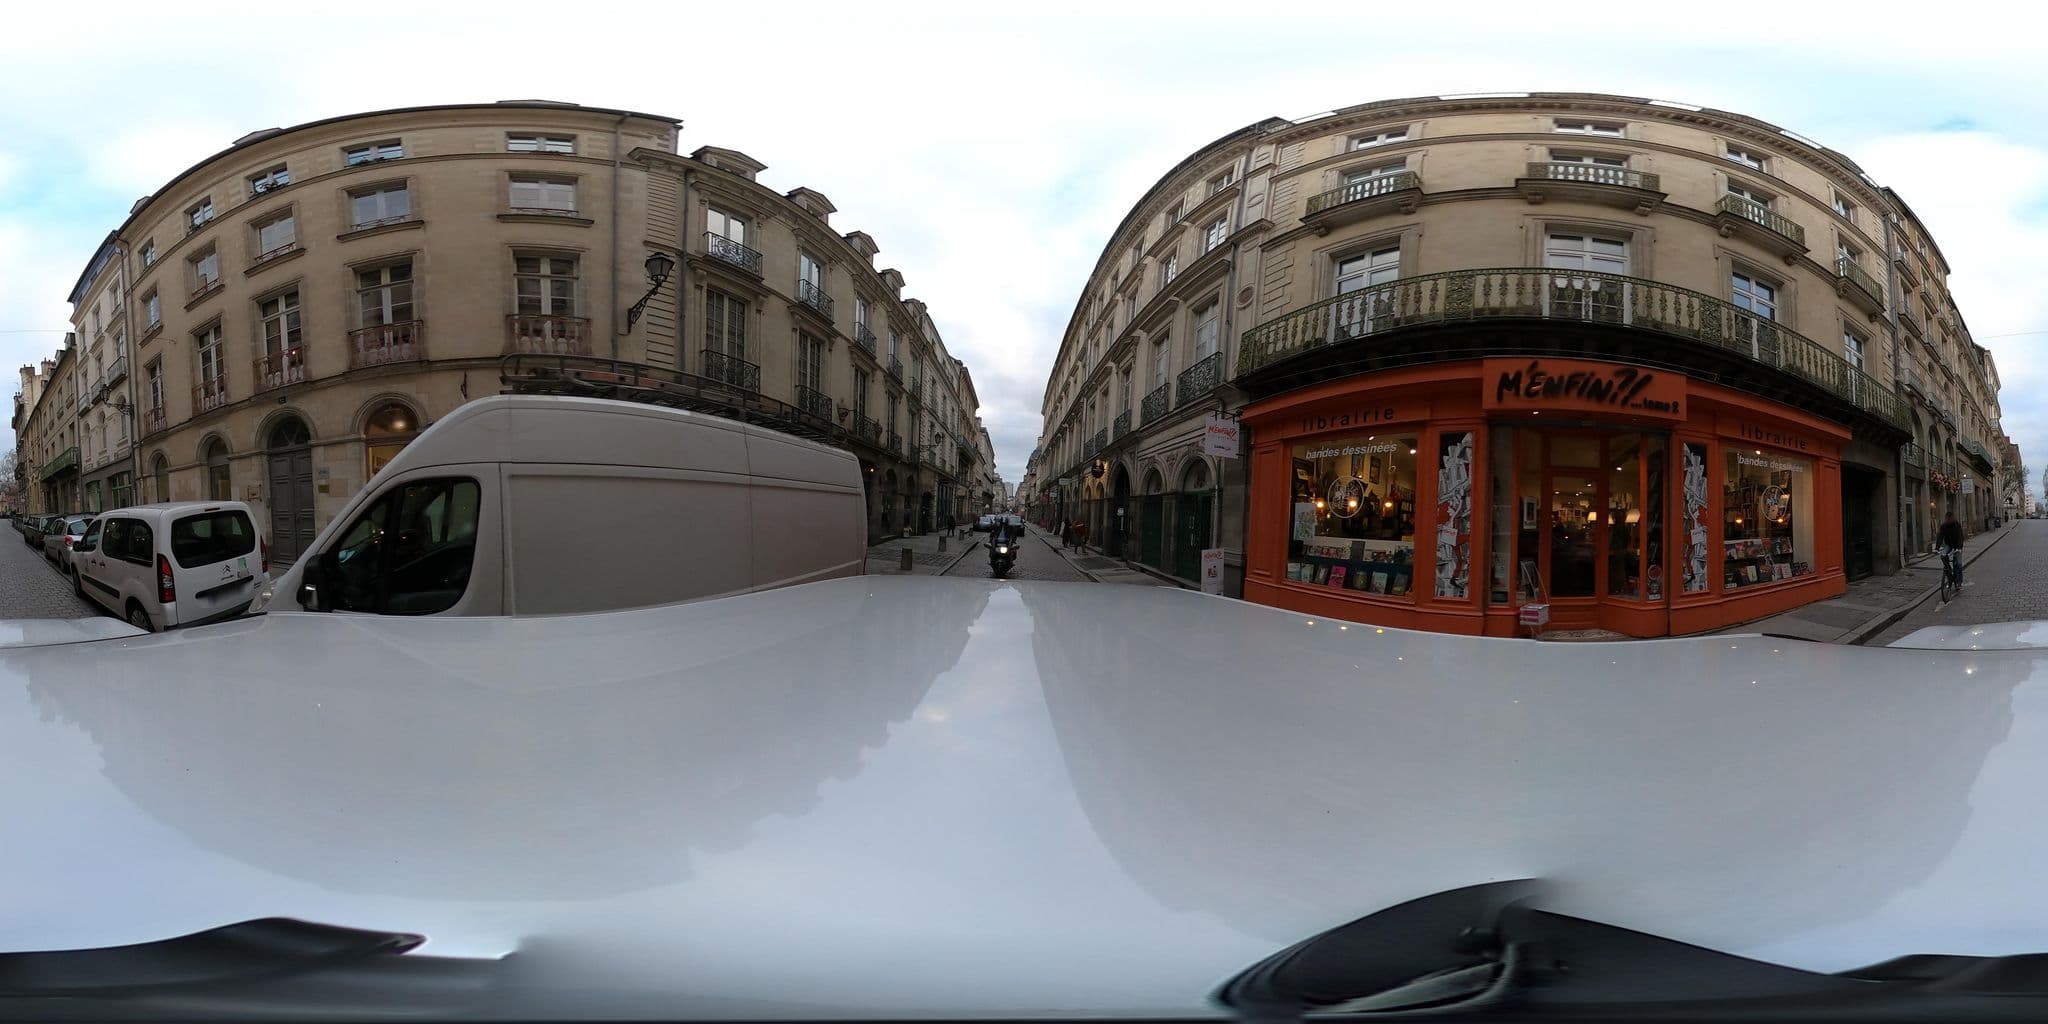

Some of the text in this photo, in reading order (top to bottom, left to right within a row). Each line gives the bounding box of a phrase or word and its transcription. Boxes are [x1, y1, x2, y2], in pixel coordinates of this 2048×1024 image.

[1302, 407, 1394, 432] librairie
[1741, 423, 1808, 449] librairie
[1305, 442, 1397, 459] bandes dessinées
[1738, 455, 1768, 468] bandes
